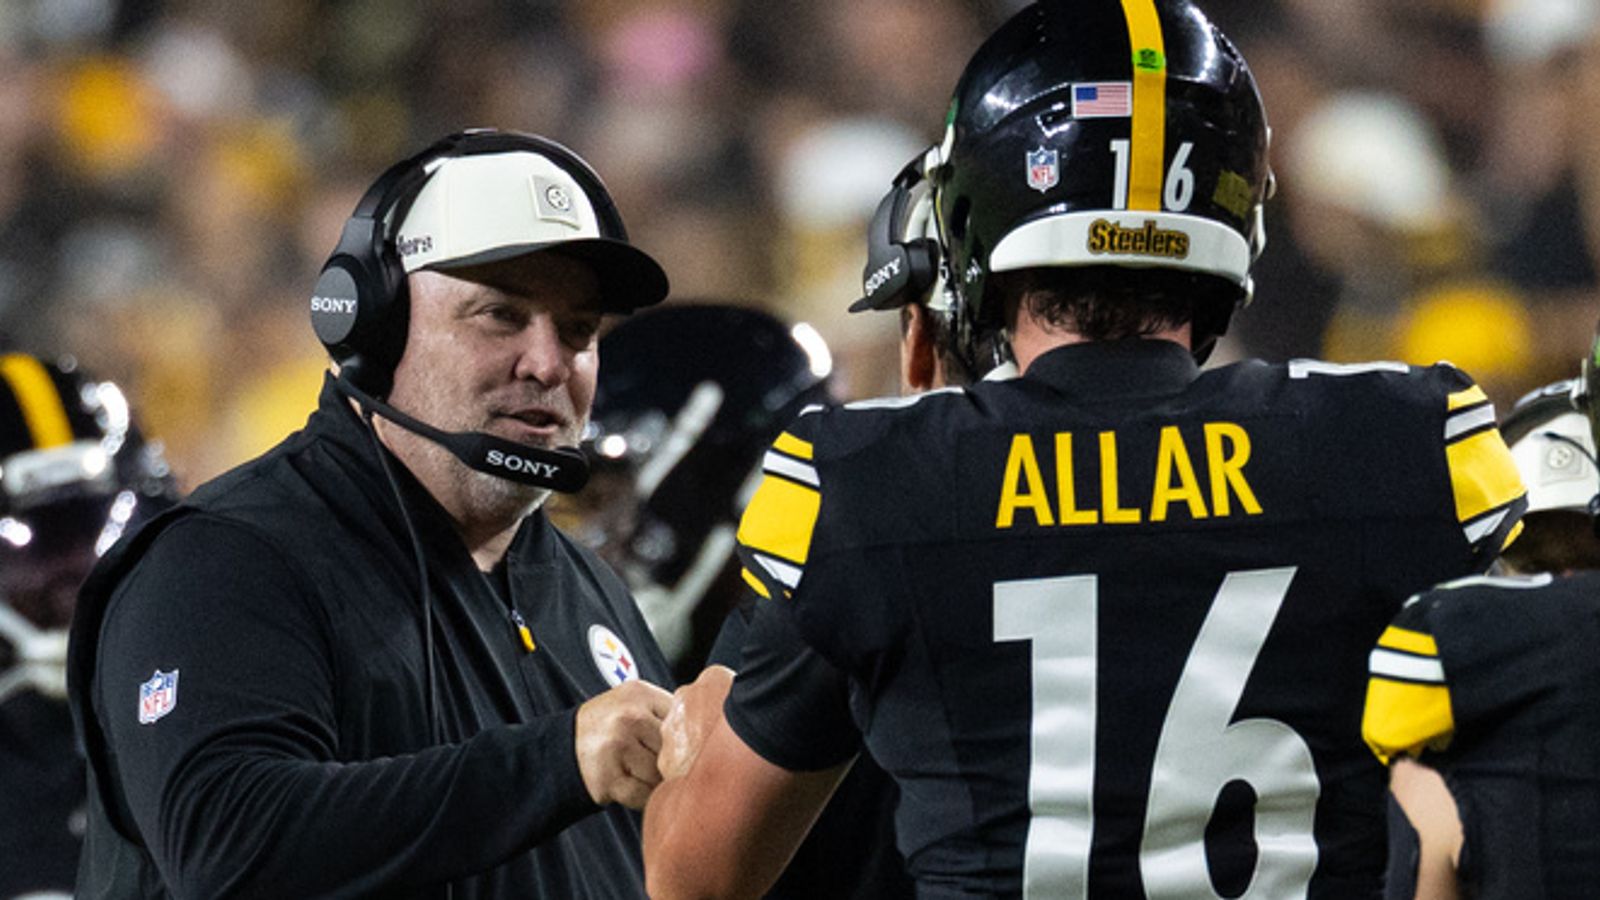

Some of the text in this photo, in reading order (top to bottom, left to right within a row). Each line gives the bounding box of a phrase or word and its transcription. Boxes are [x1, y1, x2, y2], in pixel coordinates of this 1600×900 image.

[1087, 218, 1190, 260] Steelers
[863, 257, 900, 297] SONY
[311, 296, 357, 314] SONY
[485, 449, 560, 479] SONY
[996, 422, 1263, 528] ALLAR
[993, 566, 1320, 900] 16
